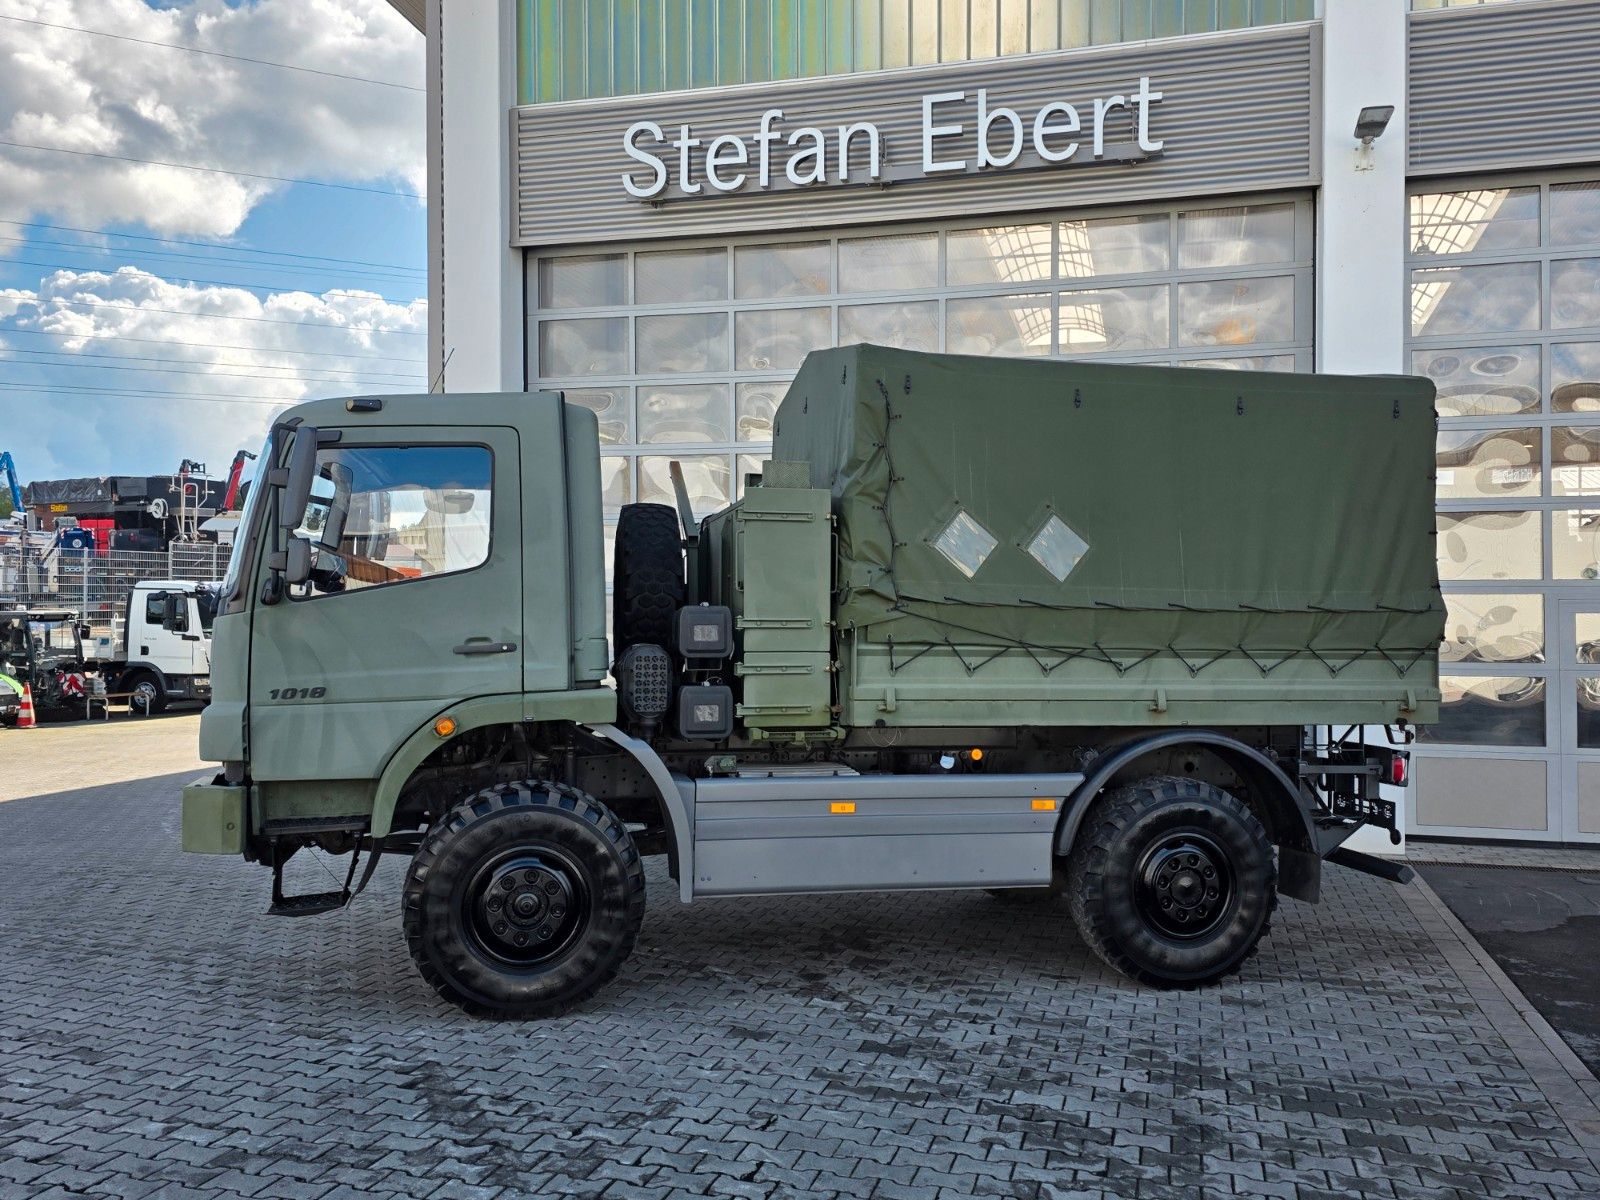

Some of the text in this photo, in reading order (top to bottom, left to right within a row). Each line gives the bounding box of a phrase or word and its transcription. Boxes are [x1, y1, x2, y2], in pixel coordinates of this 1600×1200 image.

[621, 76, 1165, 199] Stefan Ebert
[269, 686, 327, 700] 1018
